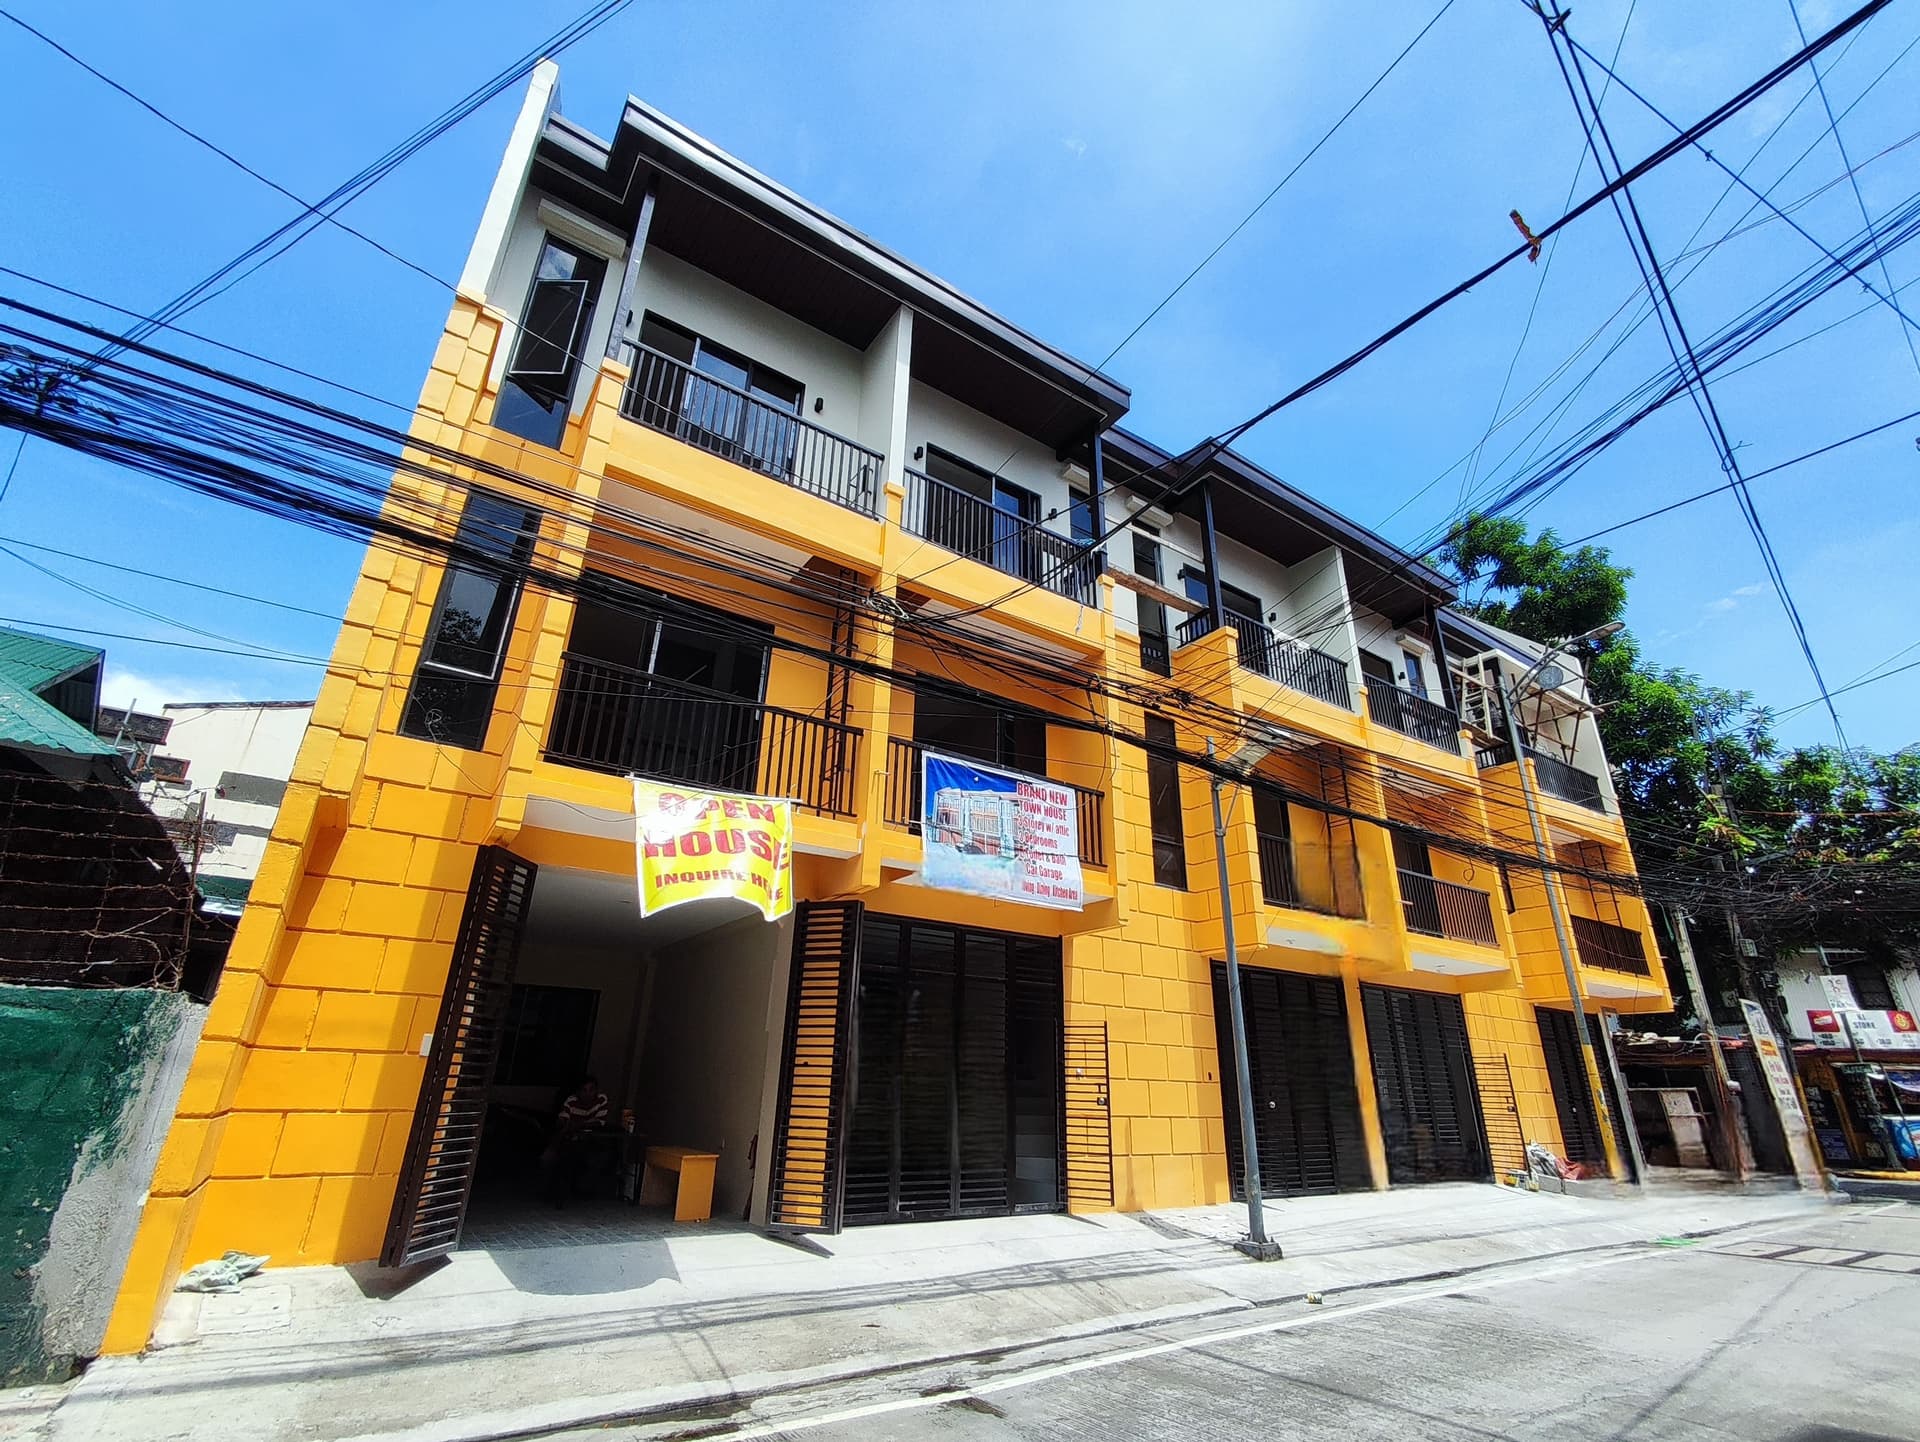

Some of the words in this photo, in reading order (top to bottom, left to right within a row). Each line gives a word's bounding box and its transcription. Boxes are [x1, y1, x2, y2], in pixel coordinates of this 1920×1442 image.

[1017, 782, 1047, 802] BRAND
[1050, 790, 1068, 806] NEW
[1018, 800, 1041, 815] TOWN
[1043, 804, 1067, 821] HOUSE
[1039, 864, 1063, 881] Garage
